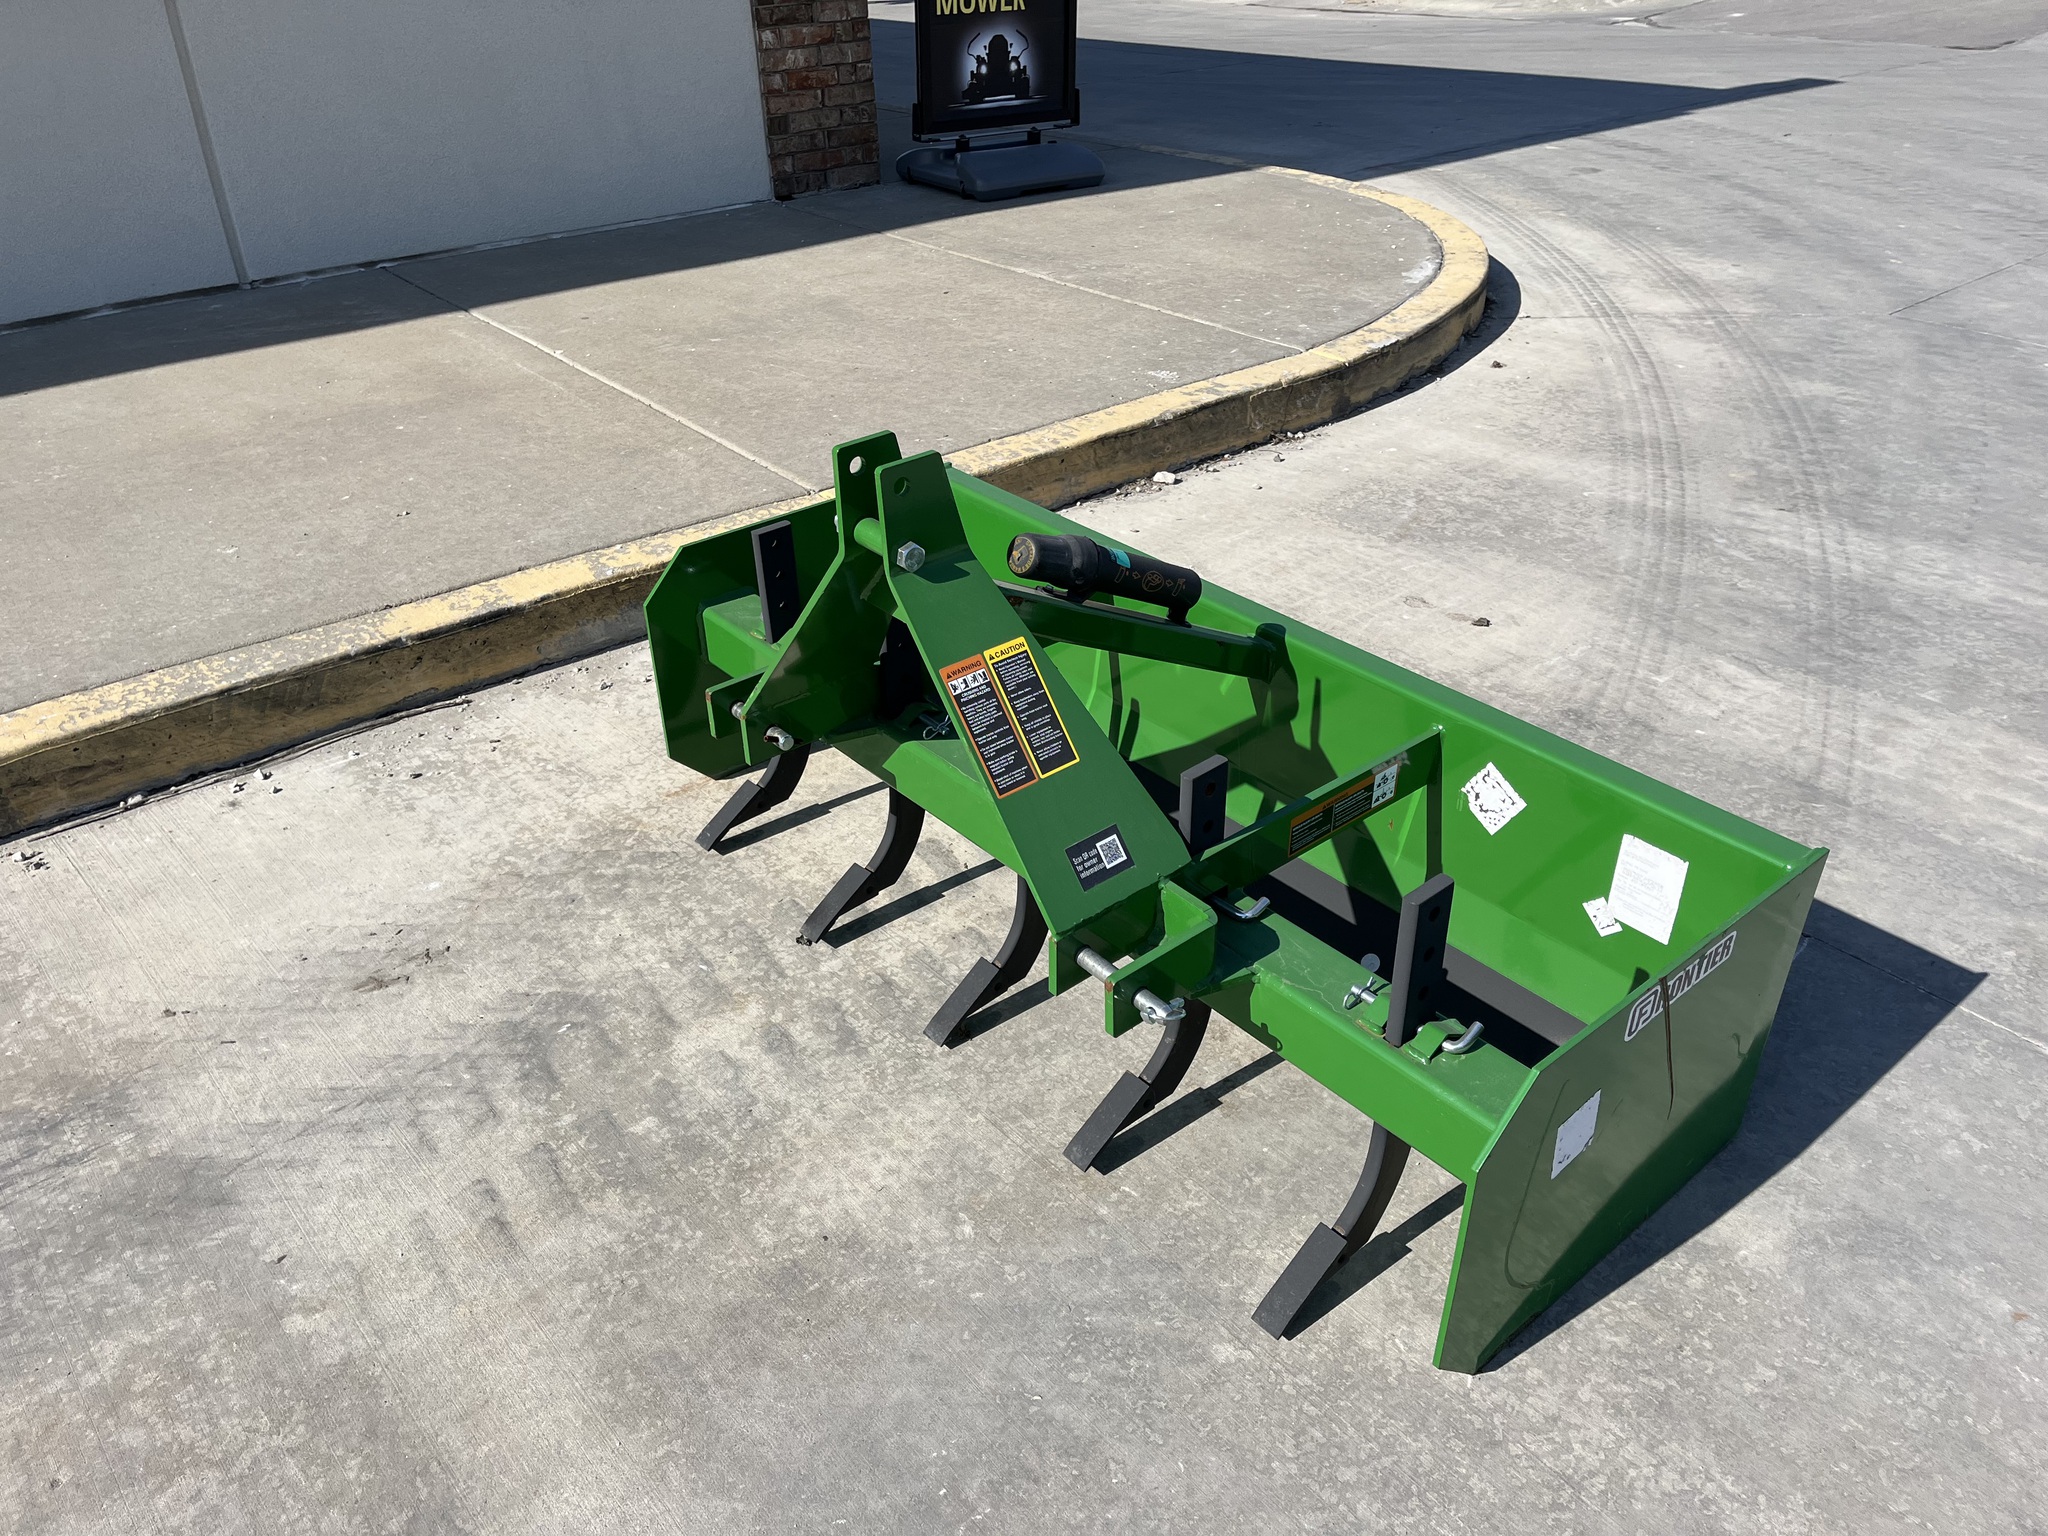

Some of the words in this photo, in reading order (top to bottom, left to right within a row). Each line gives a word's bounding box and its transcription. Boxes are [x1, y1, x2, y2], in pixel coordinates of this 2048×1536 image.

[995, 642, 1025, 657] CAUTION
[951, 661, 982, 675] WARNING
[1072, 855, 1083, 865] Scan
[1082, 852, 1088, 860] QR
[1088, 848, 1098, 857] code
[1075, 863, 1083, 871] for
[1084, 857, 1098, 868] owner
[1079, 862, 1105, 879] information
